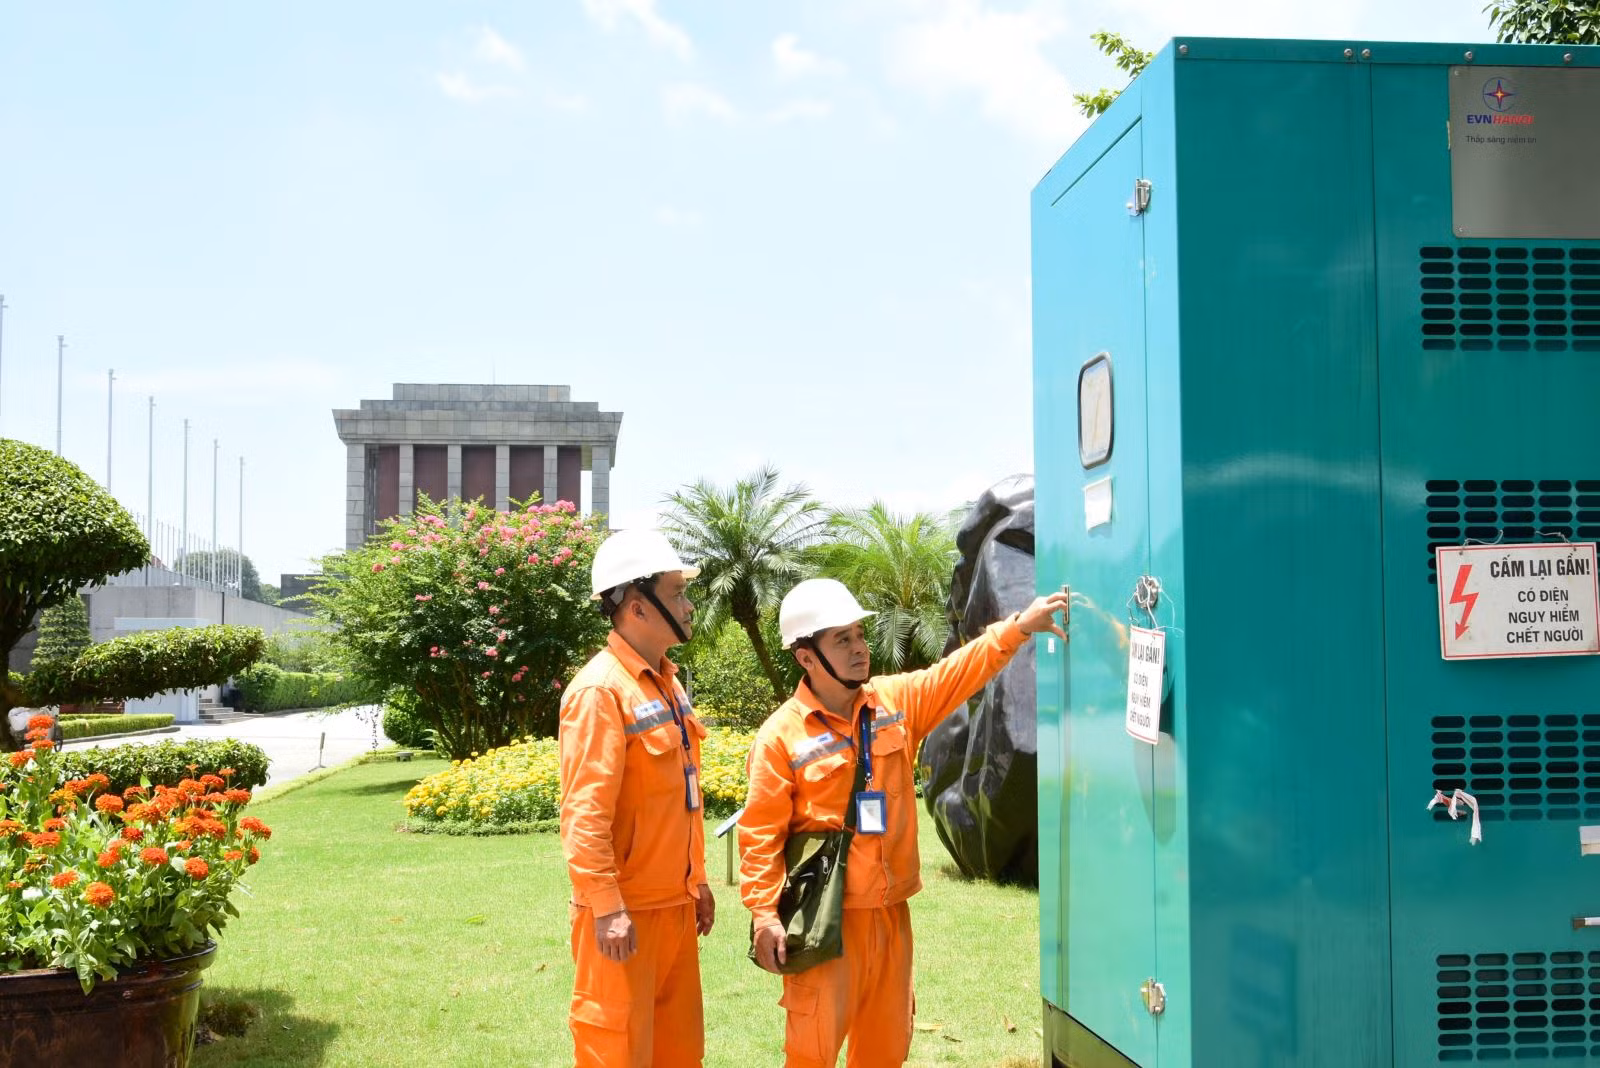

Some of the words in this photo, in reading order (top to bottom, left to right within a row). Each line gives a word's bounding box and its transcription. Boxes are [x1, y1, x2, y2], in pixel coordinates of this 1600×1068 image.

[1490, 554, 1525, 578] CẤM
[1530, 559, 1552, 580] LẠI
[1556, 553, 1590, 576] GẦN!
[1518, 587, 1536, 603] CÓ
[1540, 587, 1569, 605] ĐIỆN
[1509, 611, 1546, 623] NGUY
[1550, 604, 1579, 622] HIỂM
[1506, 626, 1540, 644] CHẾT
[1544, 627, 1584, 642] NGƯỜI
